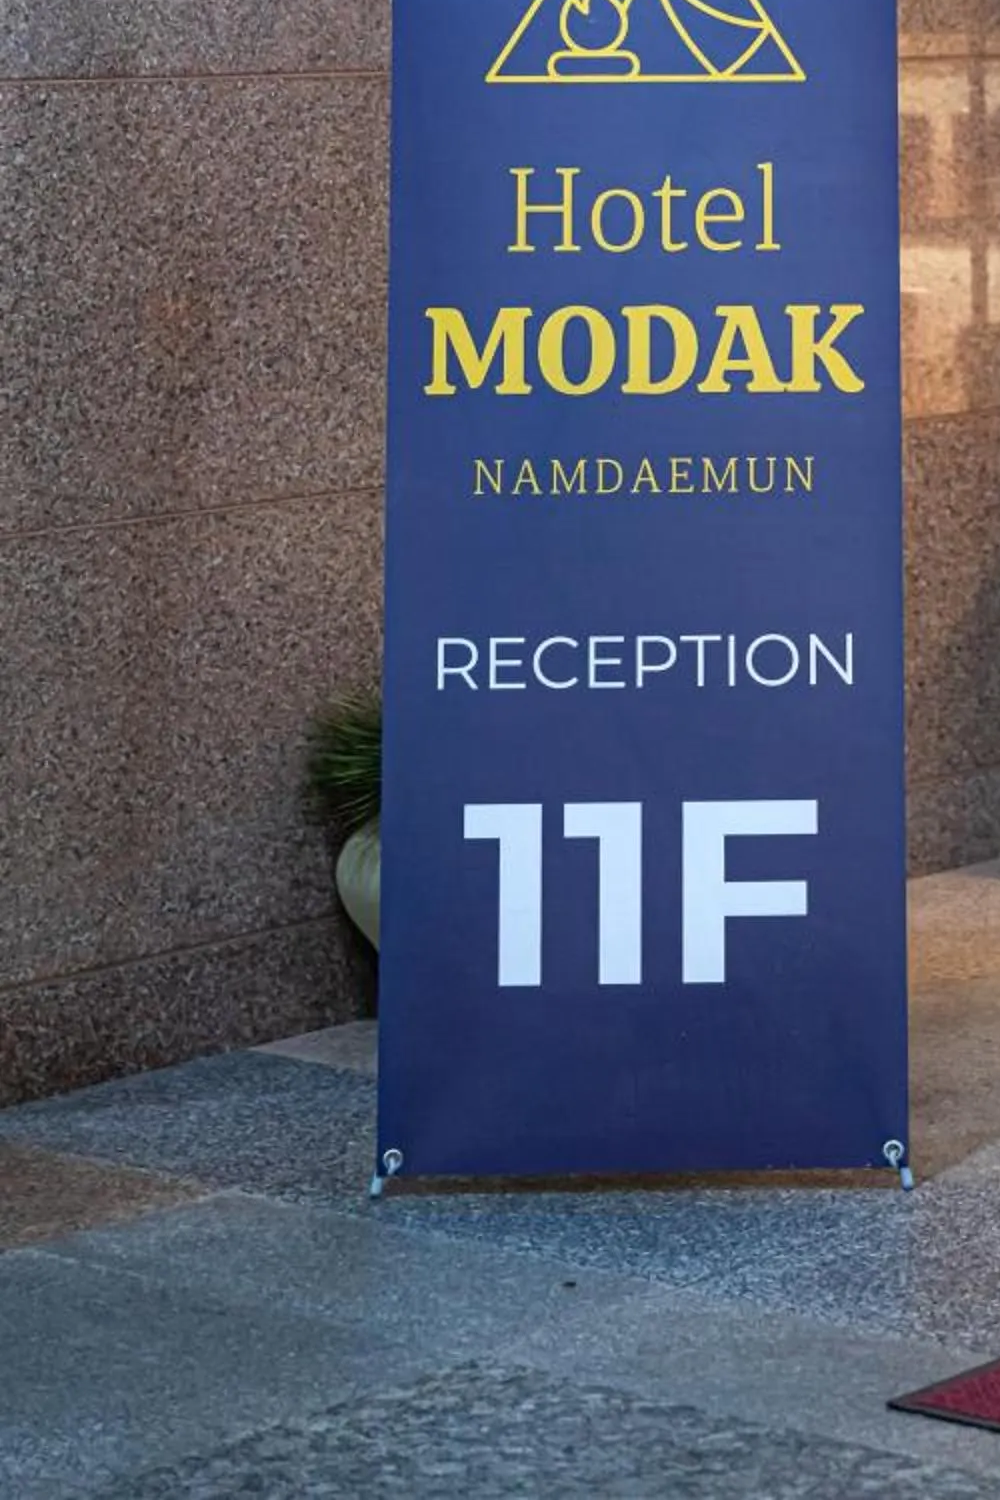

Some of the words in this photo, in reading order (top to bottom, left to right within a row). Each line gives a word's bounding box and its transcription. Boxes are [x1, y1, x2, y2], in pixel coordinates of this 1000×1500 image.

[507, 161, 781, 253] Hotel
[423, 303, 866, 396] MODAK
[472, 456, 816, 496] NAMDAEMUN
[437, 632, 855, 691] RECEPTION
[463, 799, 819, 987] 11F
